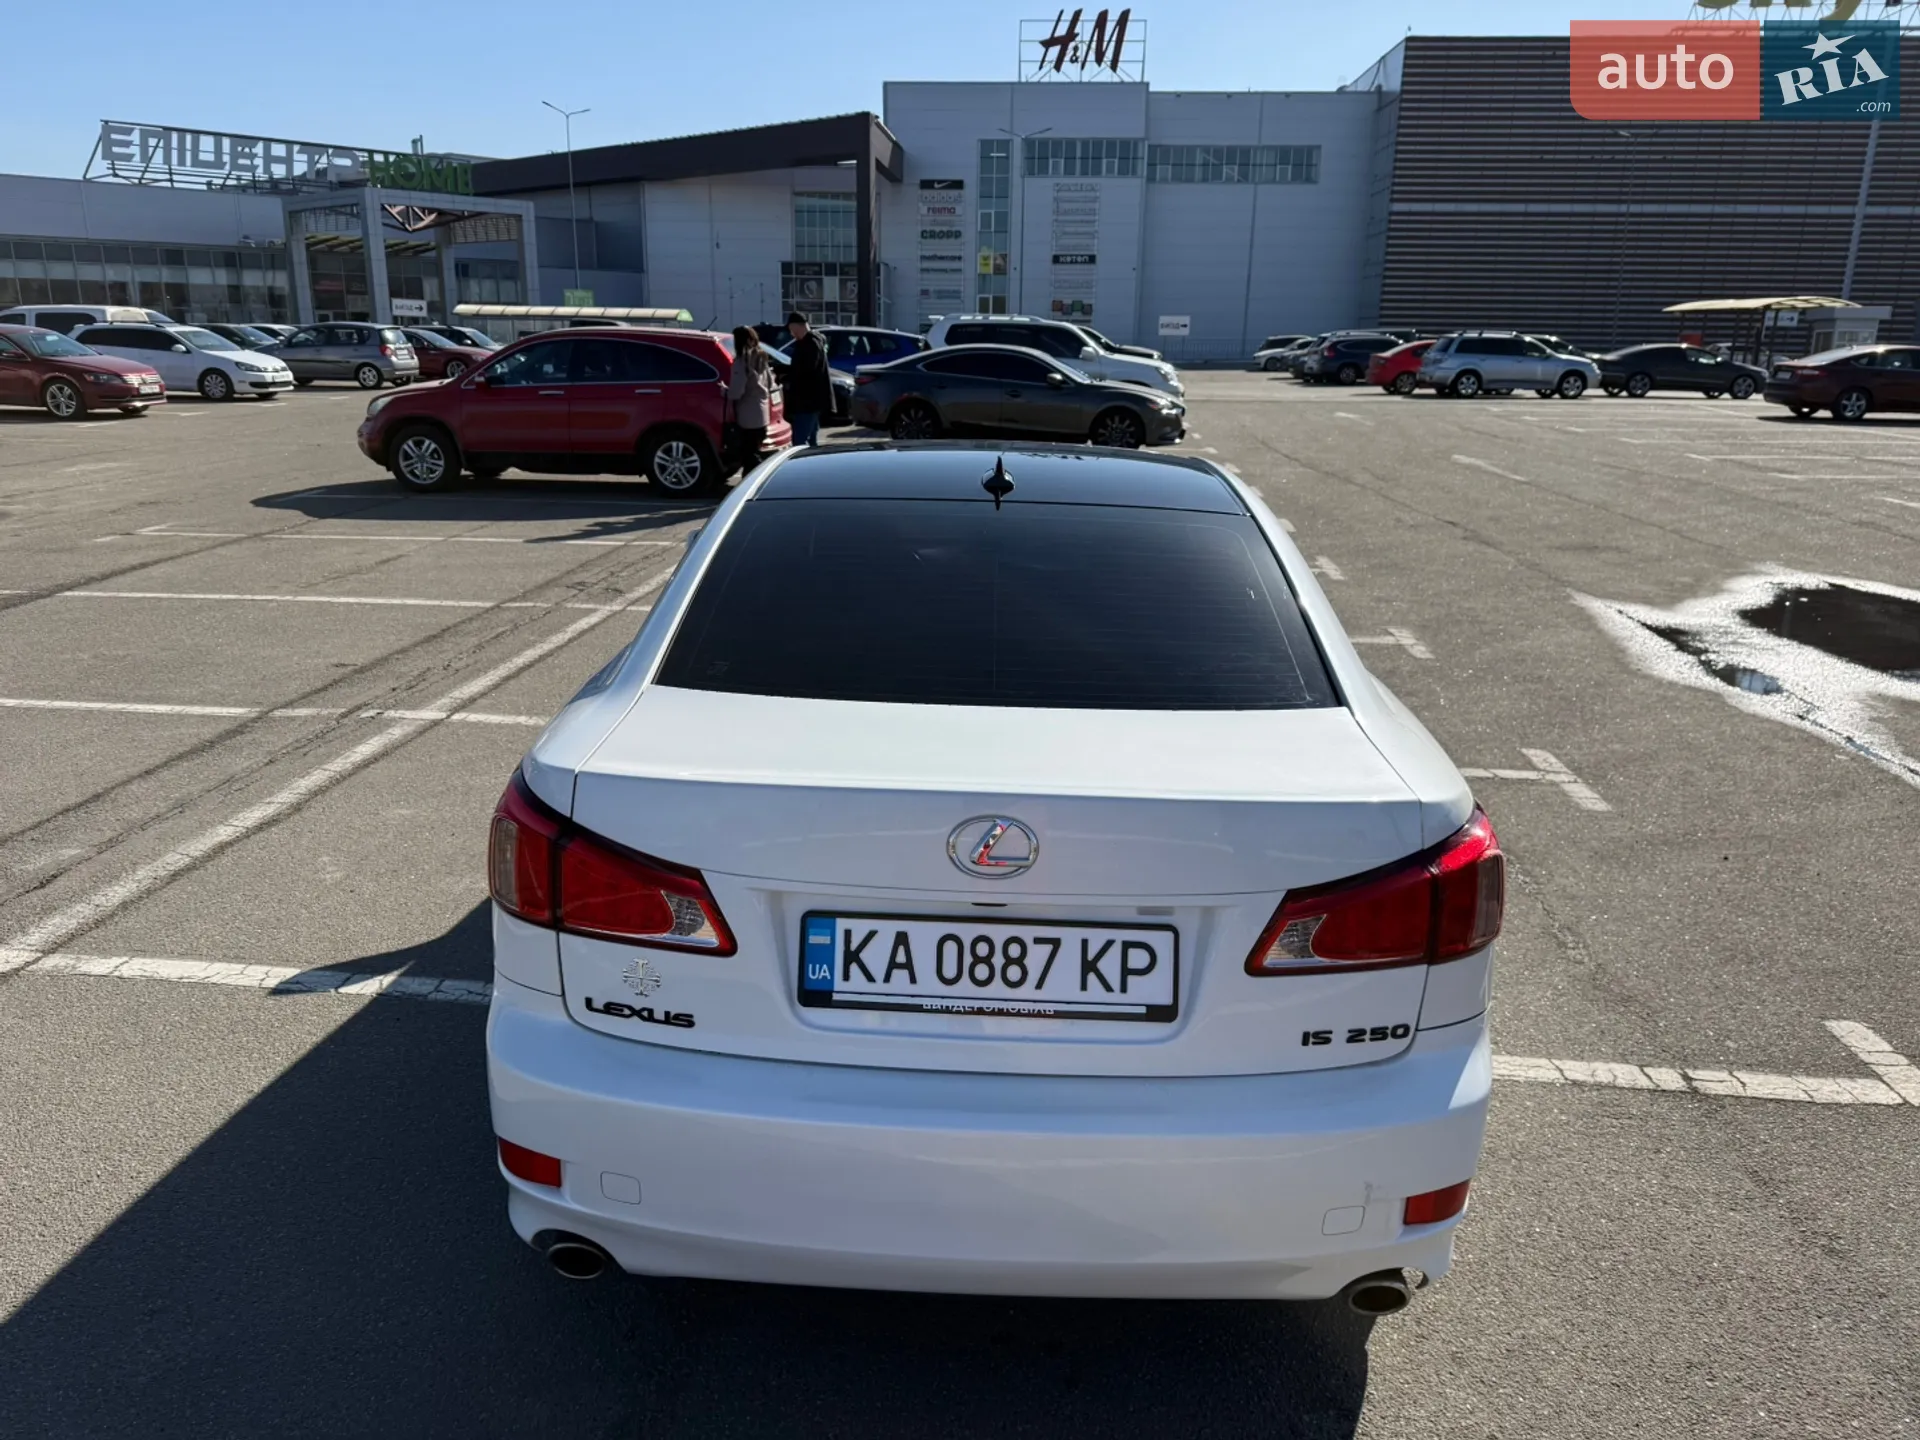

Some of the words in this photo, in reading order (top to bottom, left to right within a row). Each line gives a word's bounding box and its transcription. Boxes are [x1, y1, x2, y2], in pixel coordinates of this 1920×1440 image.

[1039, 8, 1131, 73] H&M
[101, 124, 361, 183] ЕПІЦЕНТР
[368, 151, 474, 196] HOME
[921, 230, 962, 240] CROPP
[808, 964, 831, 980] UA
[842, 929, 917, 984] KA
[935, 933, 1062, 991] 0887
[1080, 938, 1158, 994] KP
[585, 997, 696, 1028] LEXUS
[1301, 1030, 1333, 1046] IS
[1346, 1023, 1411, 1044] 250
